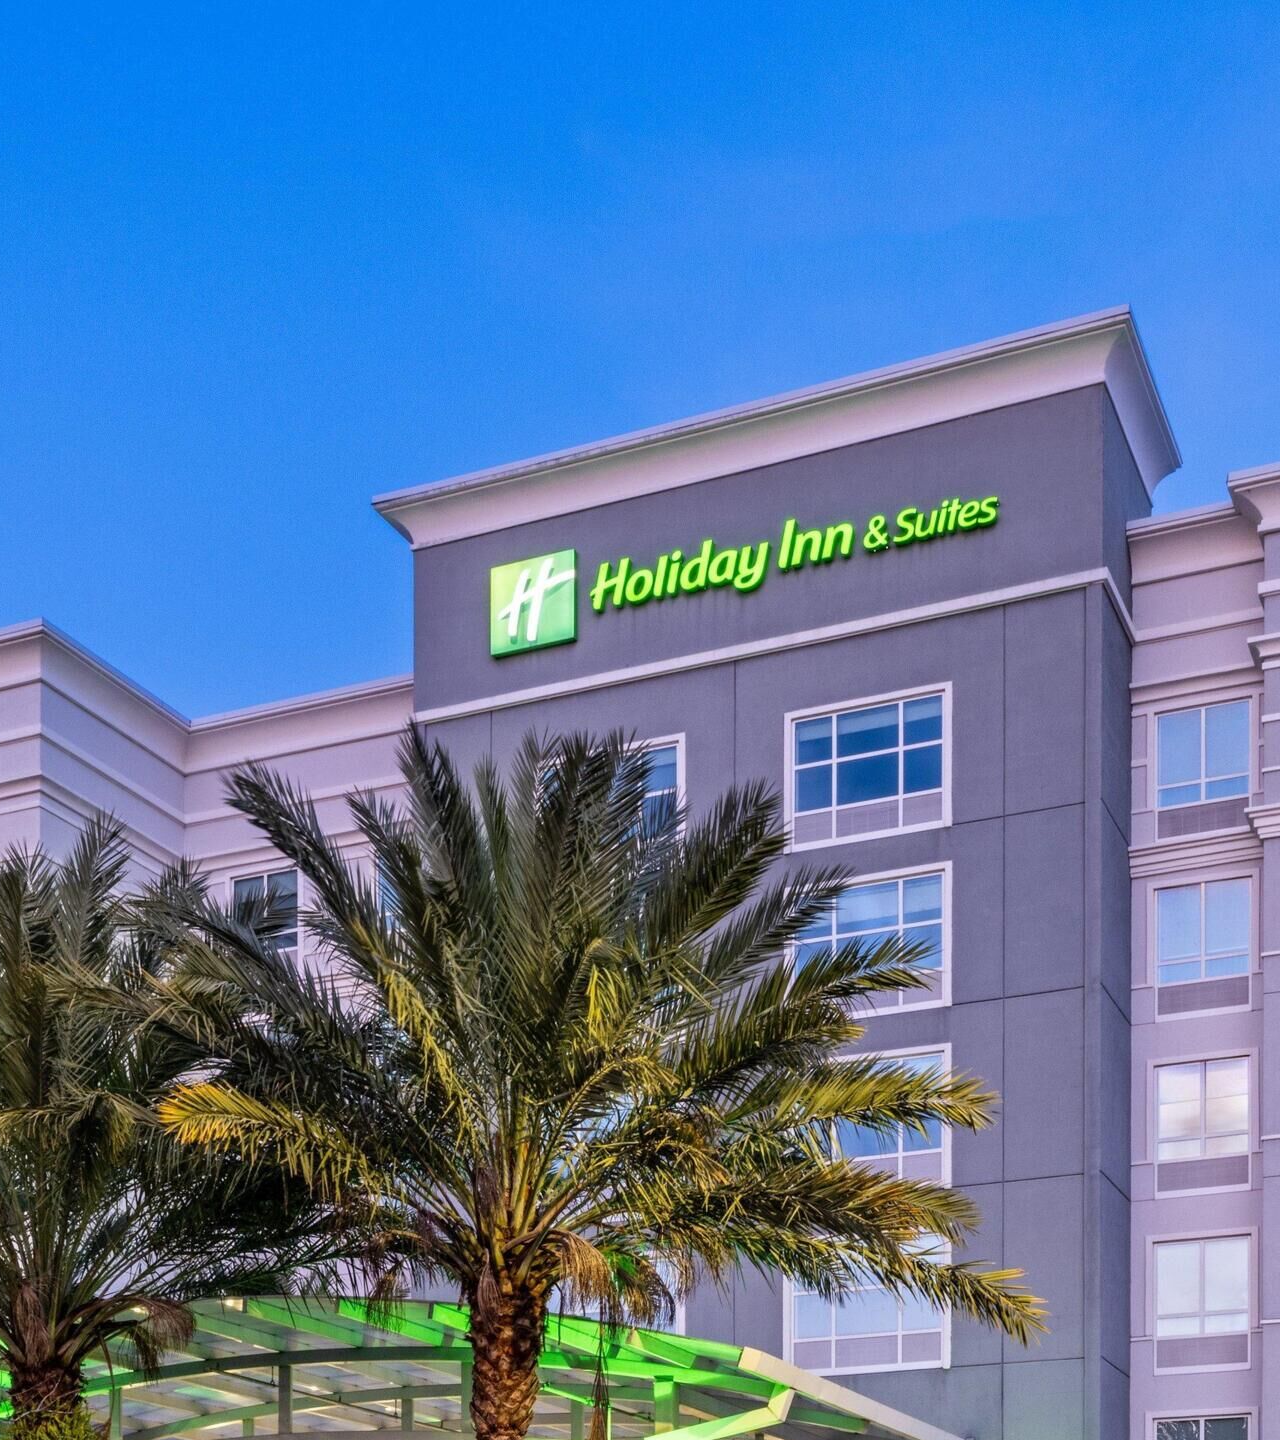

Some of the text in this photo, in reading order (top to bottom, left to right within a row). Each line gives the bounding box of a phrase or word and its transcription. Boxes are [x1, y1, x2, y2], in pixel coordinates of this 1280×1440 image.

[589, 496, 999, 612] Holiday Inn & Suites
